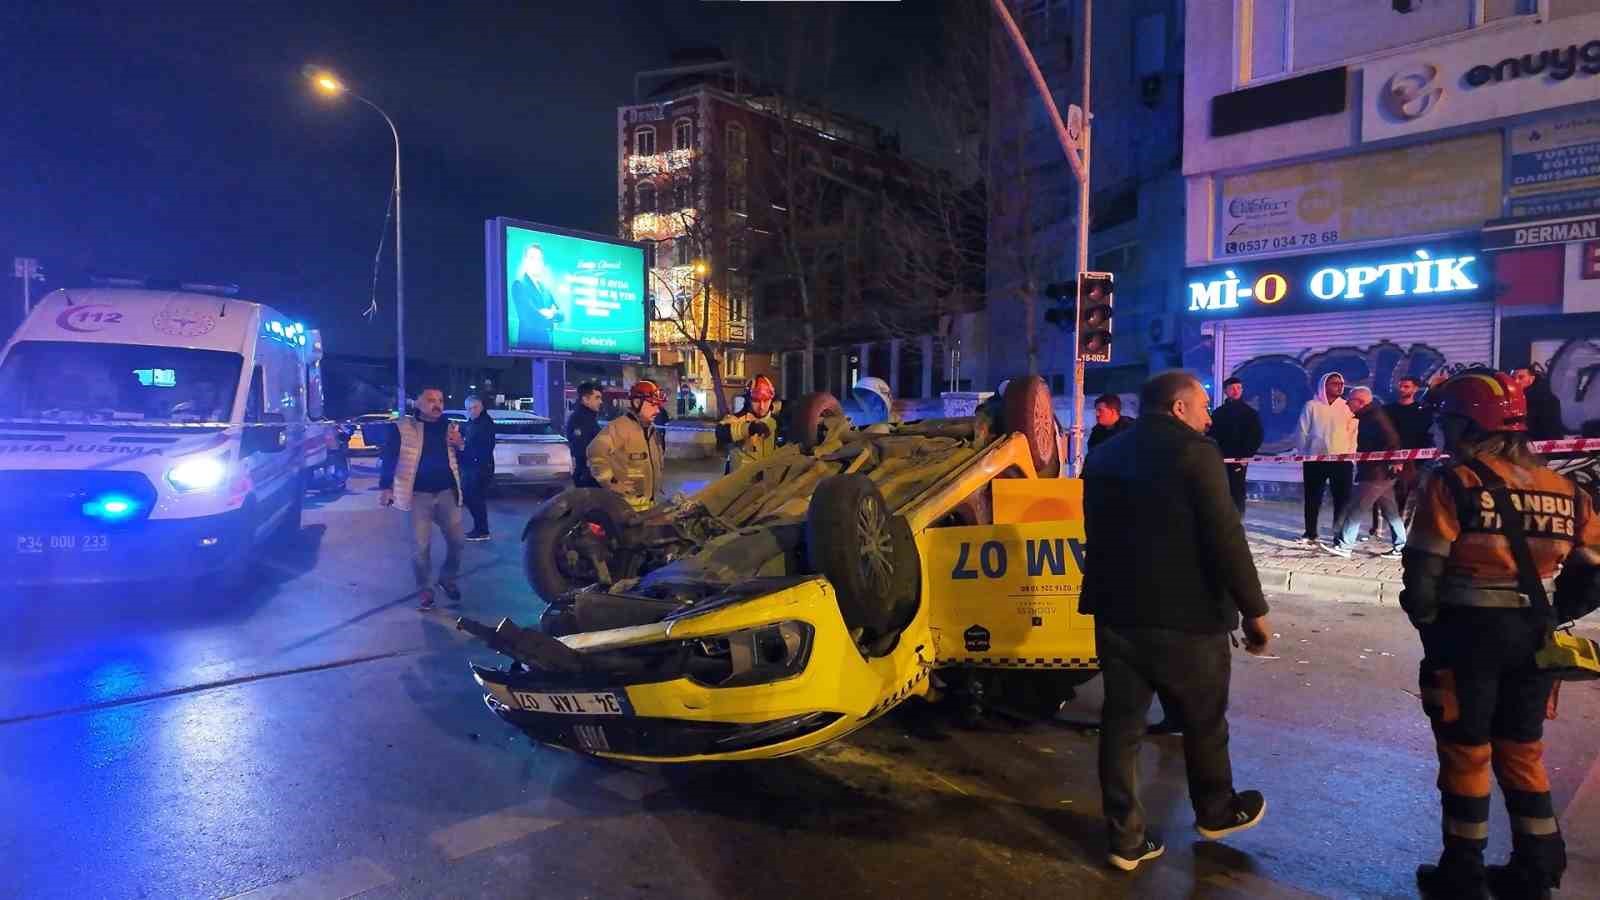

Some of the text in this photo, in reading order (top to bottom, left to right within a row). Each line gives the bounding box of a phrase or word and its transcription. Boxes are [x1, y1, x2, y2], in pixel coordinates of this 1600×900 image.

[1515, 221, 1597, 245] DERMAN
[1239, 239, 1268, 252] 0537
[1272, 236, 1296, 248] 034
[78, 311, 123, 323] 112
[952, 541, 1007, 579] 07
[549, 695, 586, 713] TAM
[595, 694, 620, 713] 34
